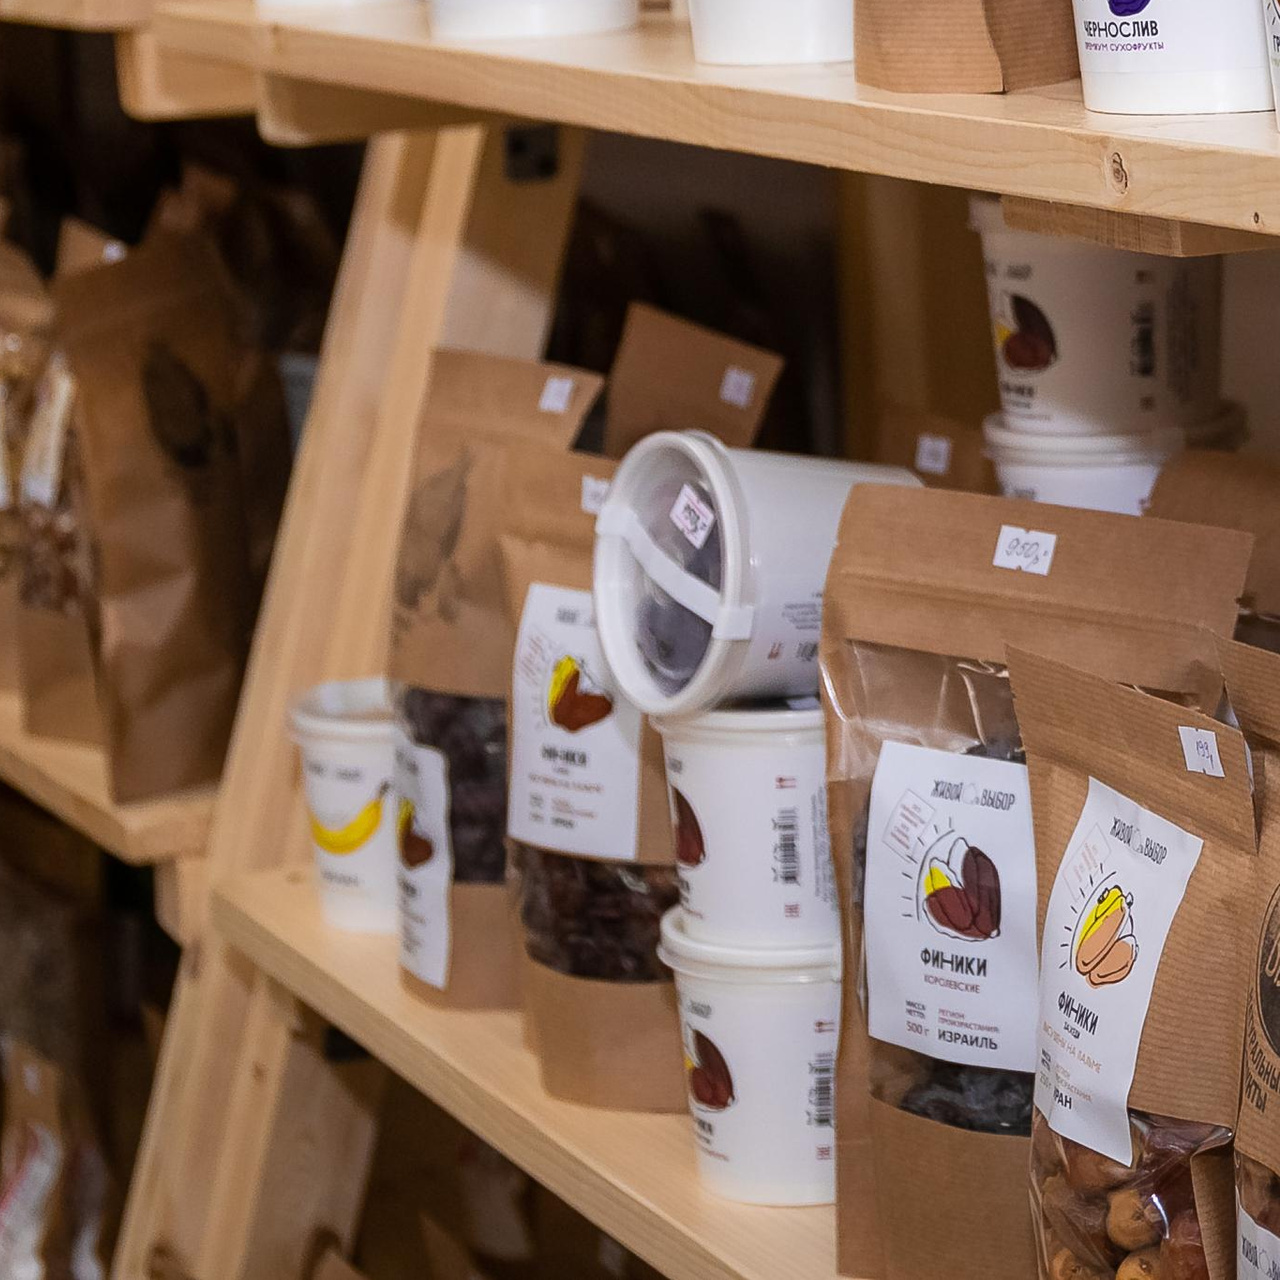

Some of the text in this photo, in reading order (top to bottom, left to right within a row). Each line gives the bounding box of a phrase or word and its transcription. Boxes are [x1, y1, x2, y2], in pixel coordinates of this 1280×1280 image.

[1084, 20, 1159, 37] ЧЕРНОСЛИВ
[1110, 41, 1164, 52] СУХОФРУКТЫ
[930, 779, 1015, 812] ЖИВОЙ ВЫБОР
[1110, 816, 1168, 866] ЖИВОЙ ВЫБОР
[921, 947, 987, 978] ФИНИКИ
[924, 974, 980, 994] КОРОЛЕВСКИЕ
[1058, 991, 1099, 1036] ФИНИКИ
[906, 1021, 923, 1035] 500
[938, 1029, 998, 1051] ИЗРАИЛЬ
